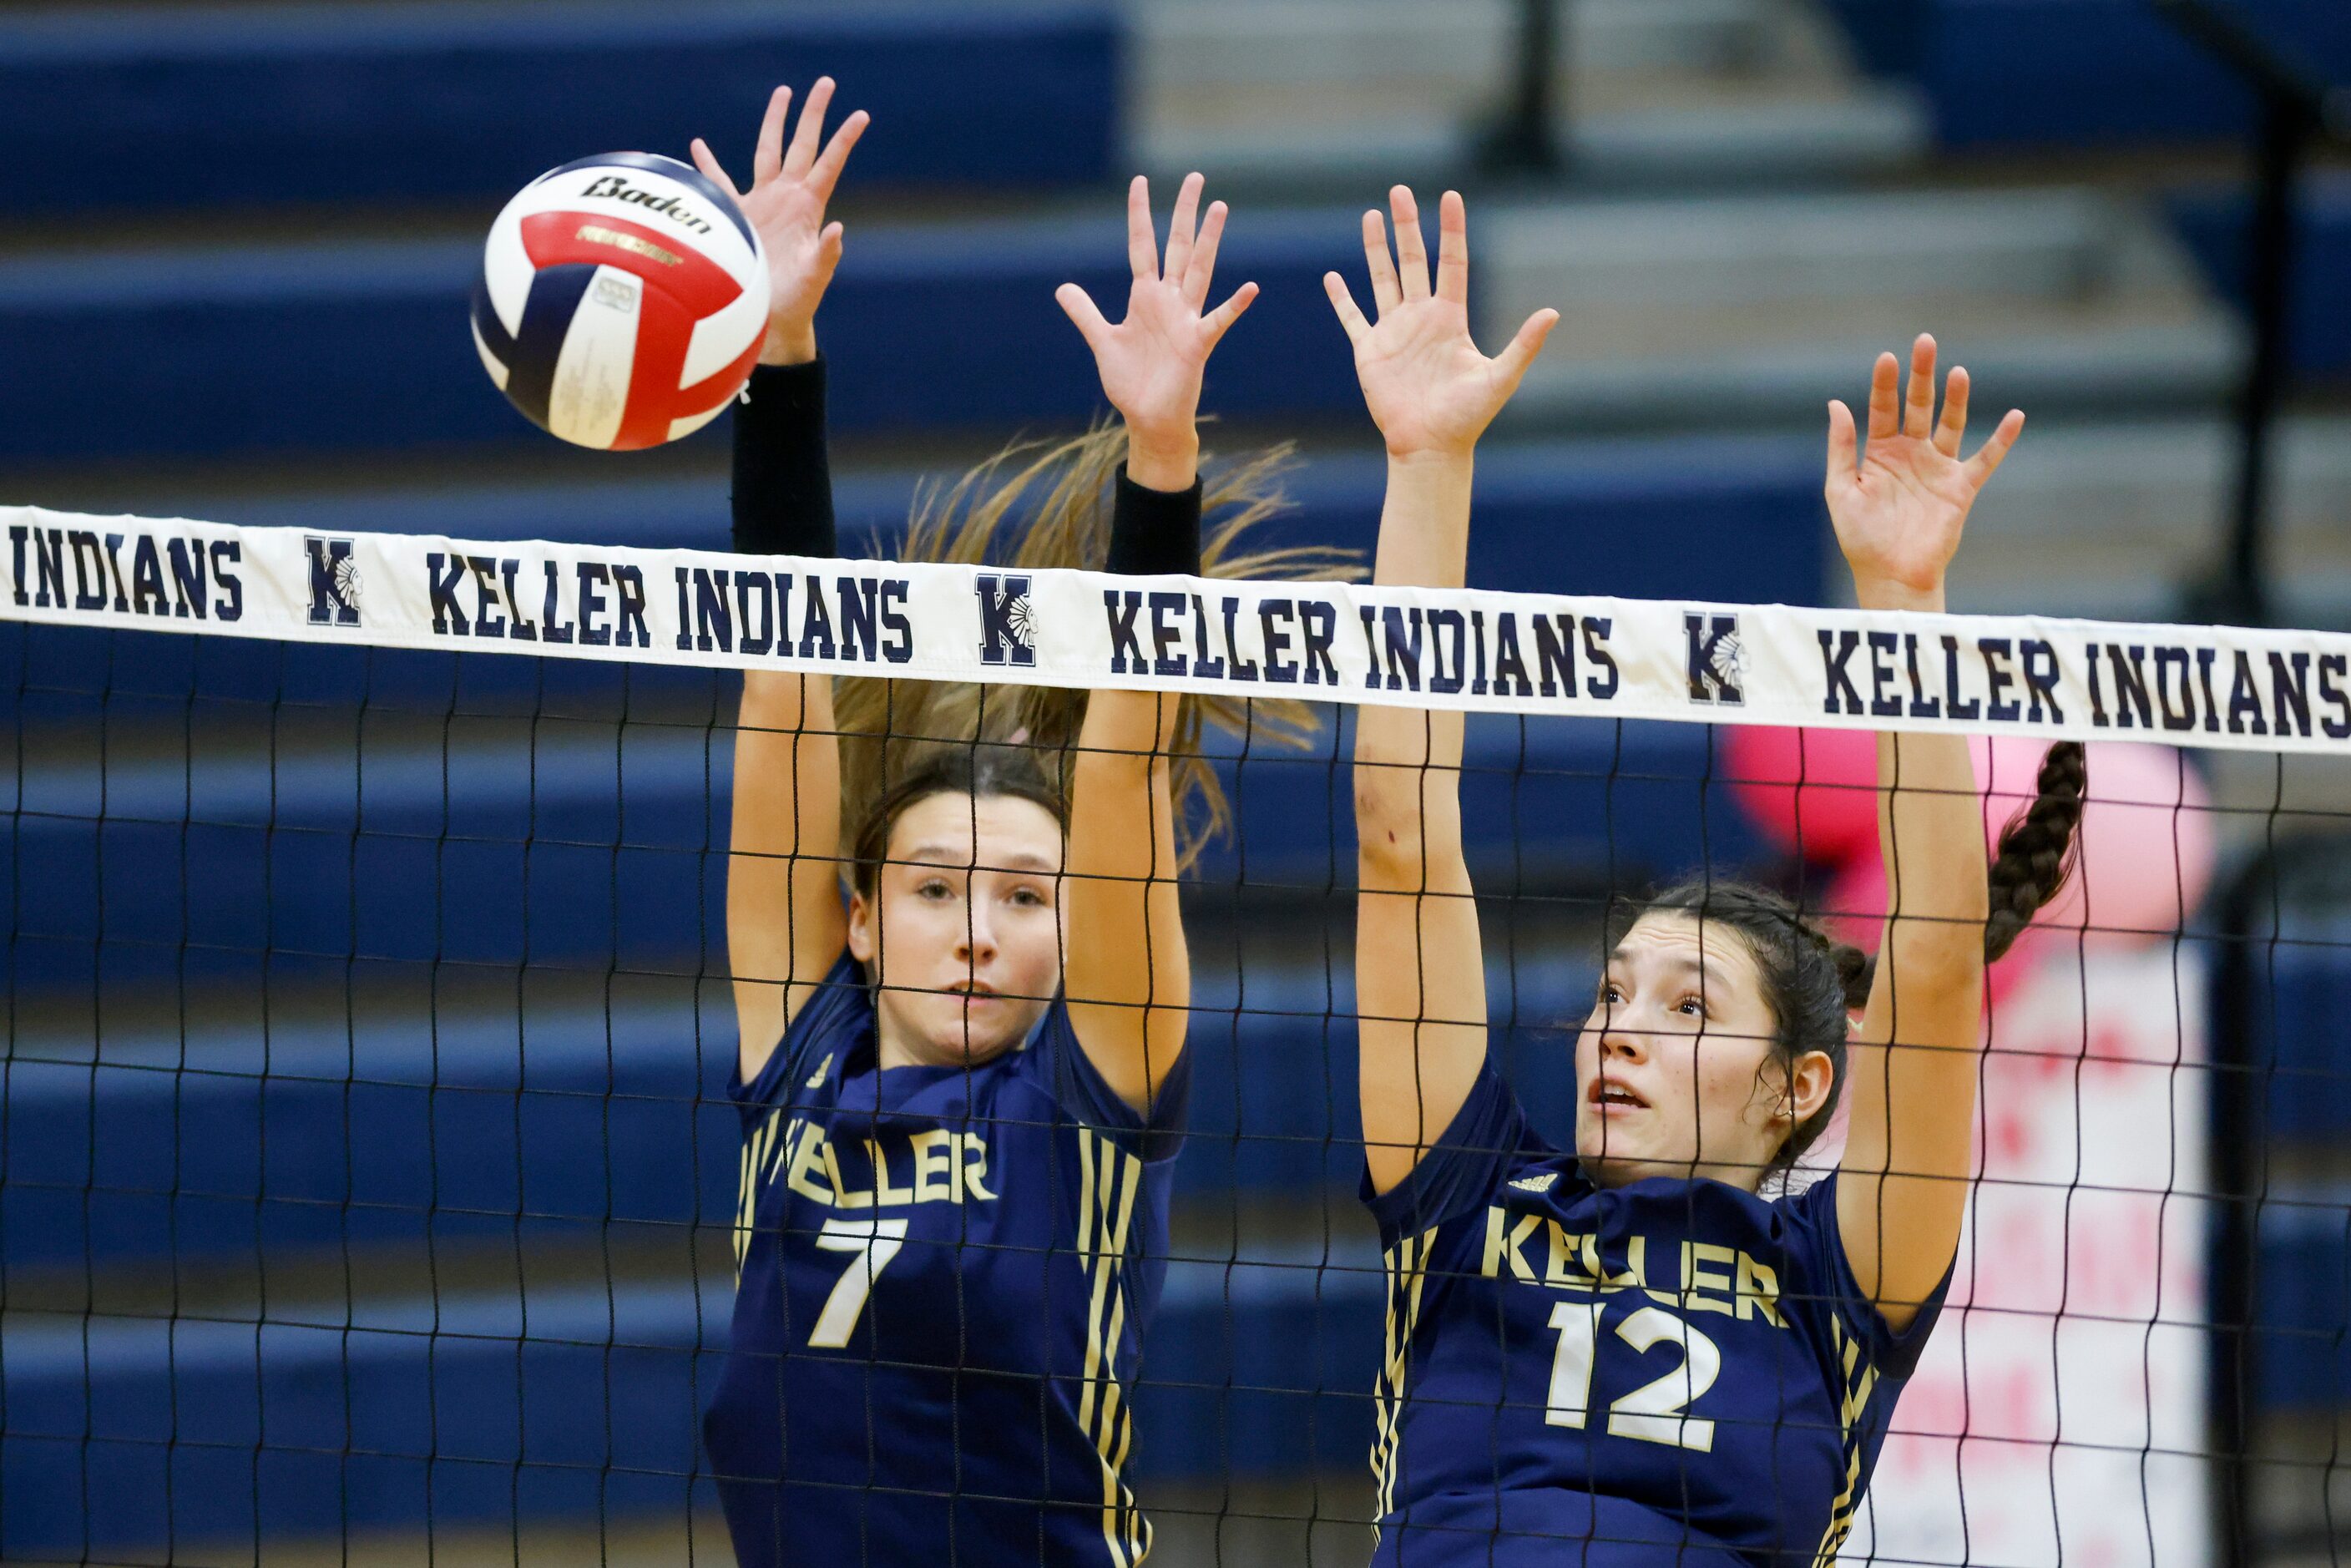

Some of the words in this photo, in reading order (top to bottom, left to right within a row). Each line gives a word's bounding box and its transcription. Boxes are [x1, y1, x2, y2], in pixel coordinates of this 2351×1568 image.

[579, 175, 711, 235] Baden
[8, 525, 243, 622] INDIANS
[426, 552, 651, 648] KELLER
[675, 567, 913, 664] INDIANS
[1104, 589, 1339, 686] KELLER
[1360, 604, 1620, 701] INDIANS
[1817, 630, 2065, 724] KELLER
[2085, 643, 2351, 739] INDIANS
[807, 1218, 909, 1348] 7
[1481, 1205, 1791, 1329] KELLER
[1545, 1302, 1722, 1453] 12
